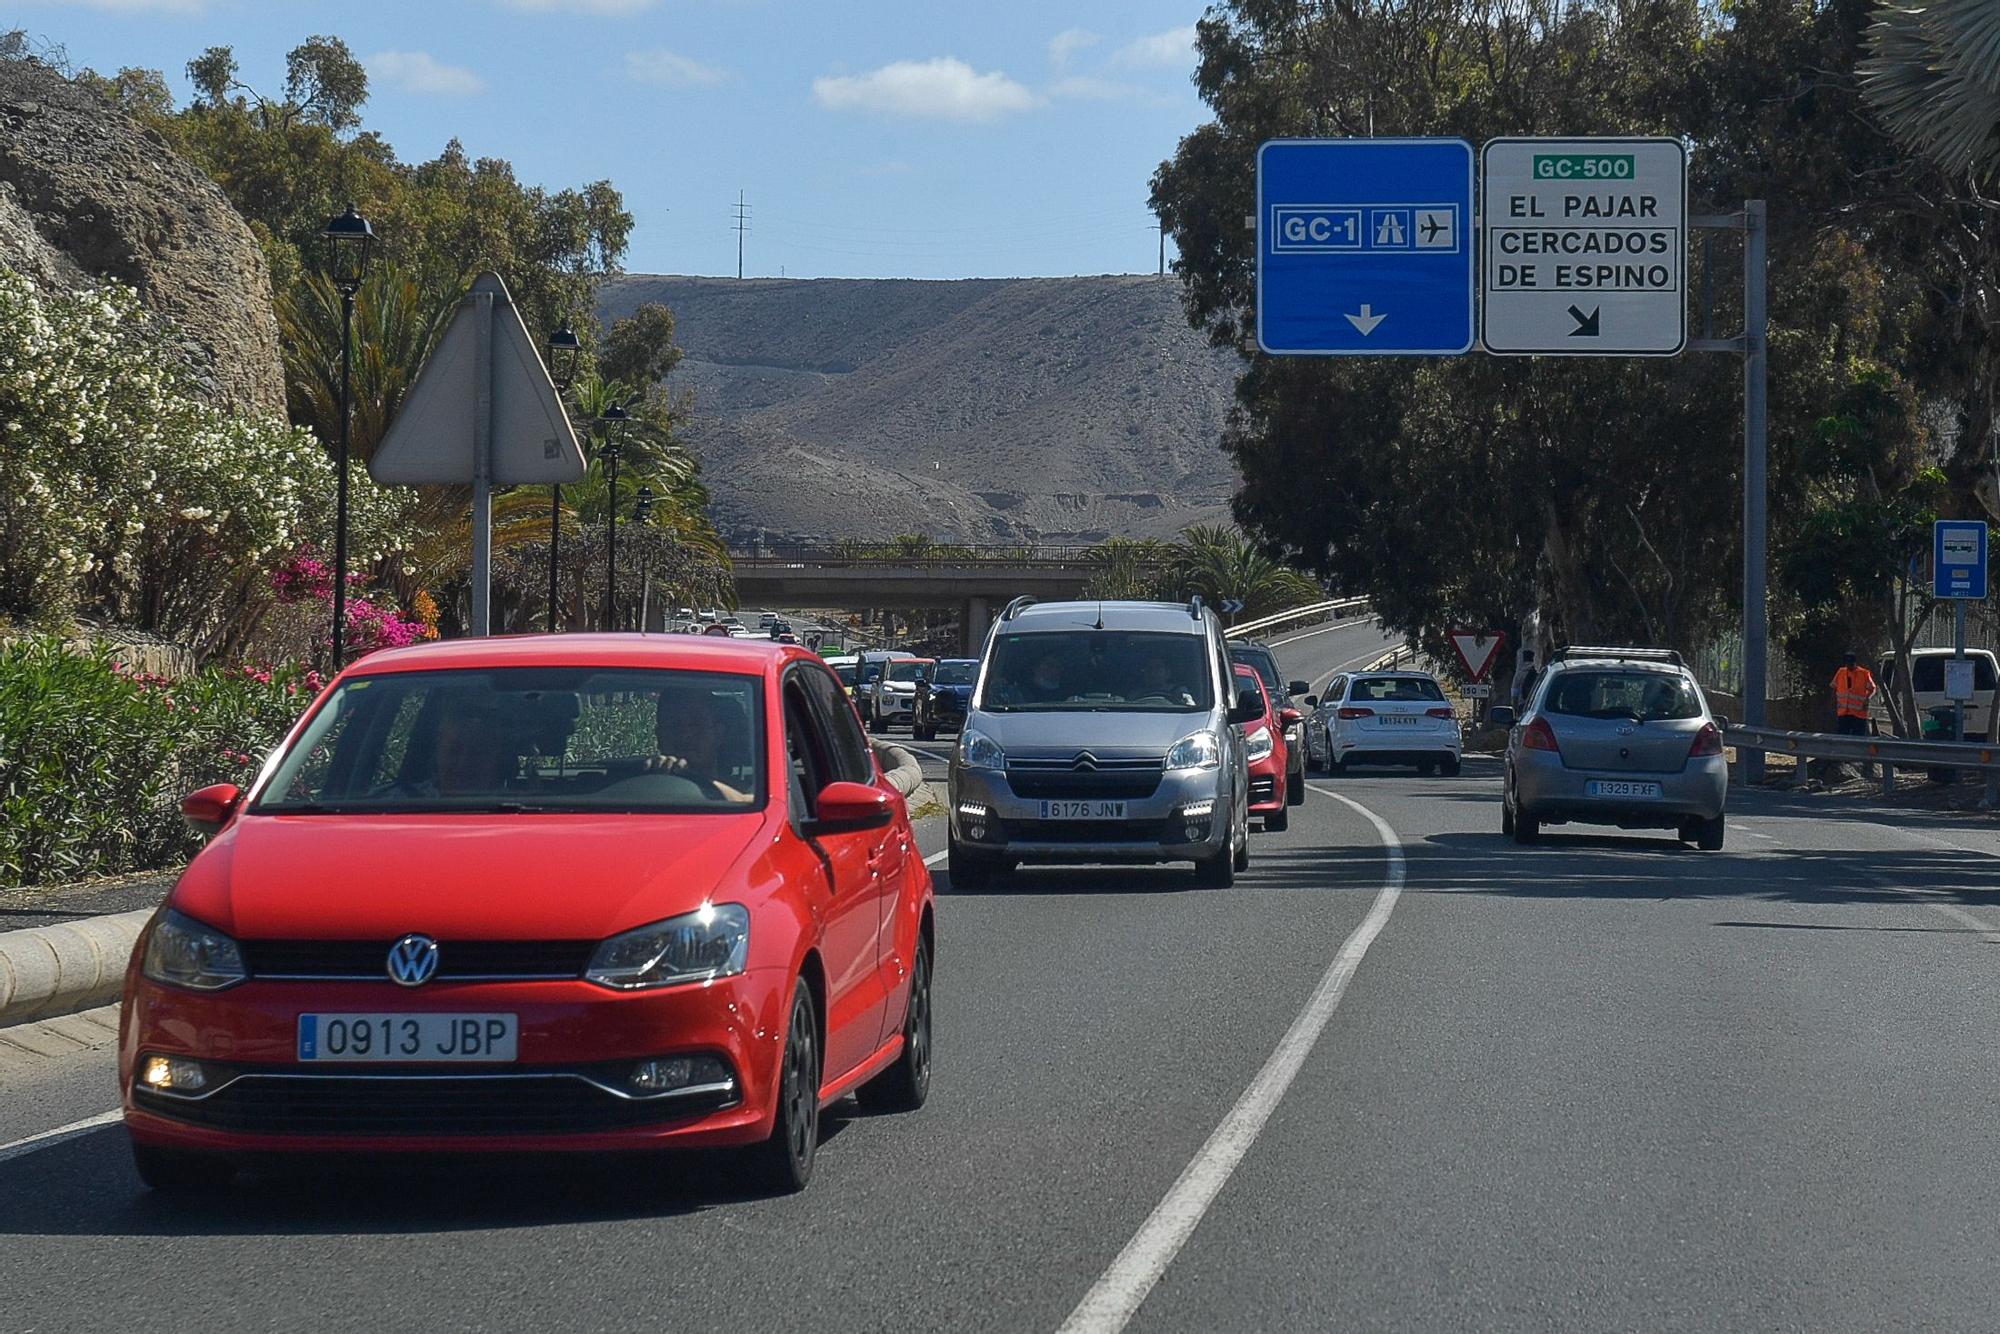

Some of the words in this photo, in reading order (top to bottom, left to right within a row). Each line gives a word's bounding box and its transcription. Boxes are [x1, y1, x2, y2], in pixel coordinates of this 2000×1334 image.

[1538, 159, 1629, 177] GC-500
[1510, 196, 1545, 218] EL
[1564, 196, 1657, 218] PAJAR
[1284, 217, 1355, 241] GC-1
[1500, 232, 1668, 254] CERCADOS
[1499, 265, 1537, 287] DE
[1556, 265, 1669, 287] ESPINO
[1463, 687, 1477, 695] 150
[1600, 783, 1629, 795] 1329
[1632, 784, 1656, 796] FXF
[1051, 802, 1090, 817] 6176
[1095, 802, 1124, 817] JNW
[327, 1018, 421, 1055] 0913
[436, 1018, 507, 1055] JBP
